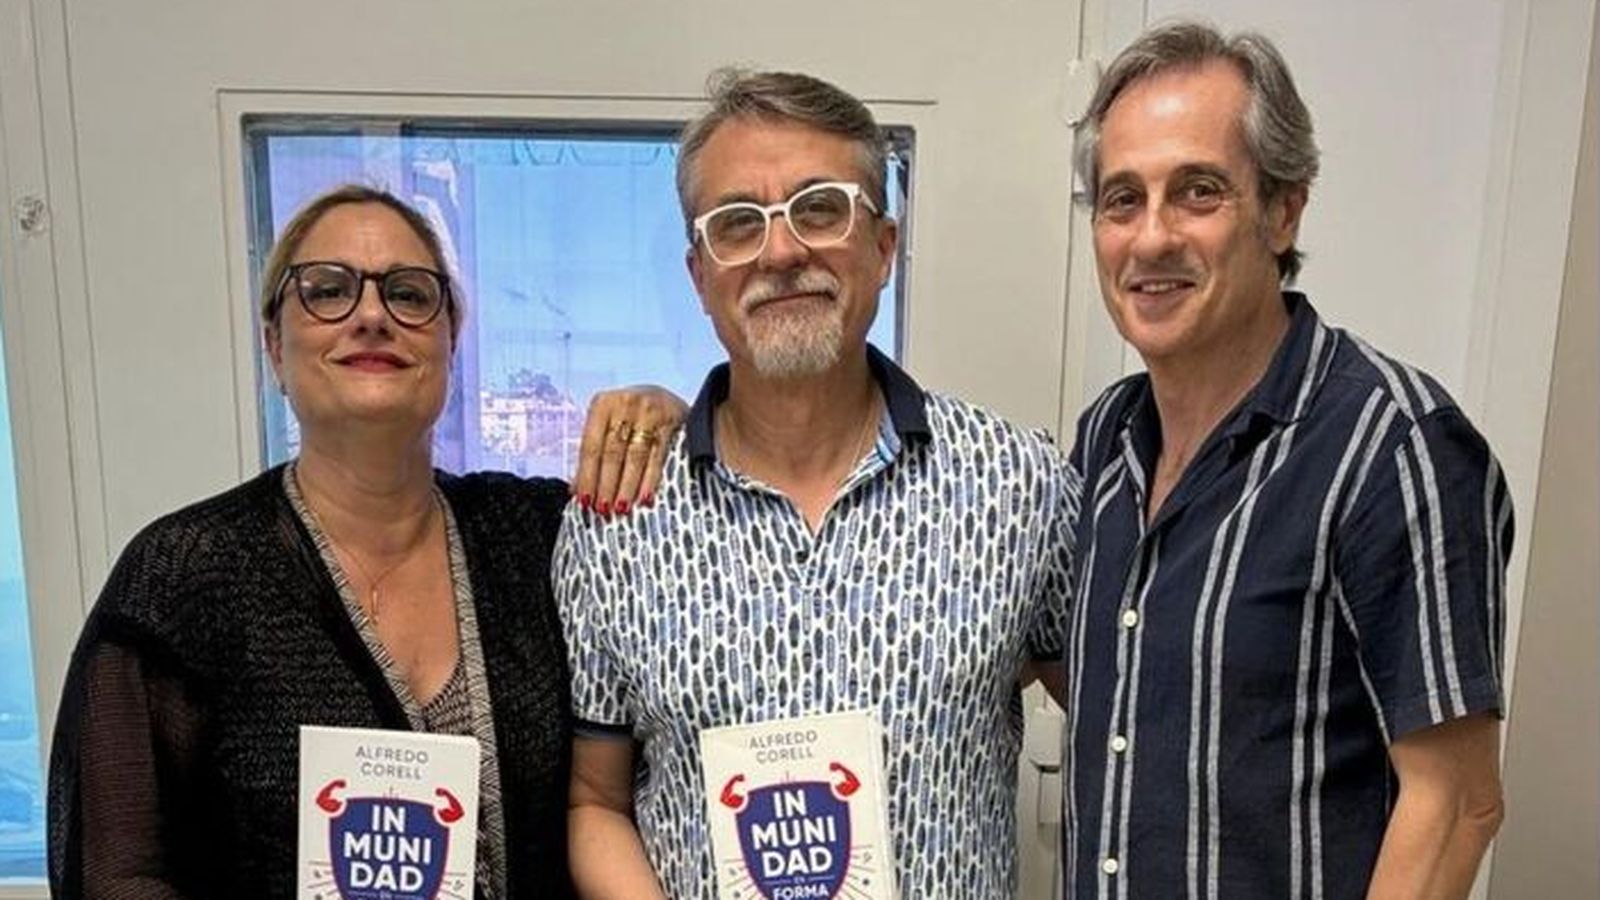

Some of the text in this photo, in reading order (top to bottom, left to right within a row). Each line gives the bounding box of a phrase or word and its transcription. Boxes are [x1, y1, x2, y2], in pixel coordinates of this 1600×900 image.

[749, 730, 818, 749] ALFREDO
[355, 746, 429, 763] ALFREDO
[756, 747, 814, 764] CORELL
[360, 762, 422, 780] CORELL
[773, 790, 807, 818] IN
[372, 805, 406, 832] IN
[751, 816, 836, 849] MUNI
[343, 832, 432, 864] MUNI
[762, 847, 833, 877] DAD
[350, 861, 423, 892] DAD
[773, 883, 829, 900] FORMA
